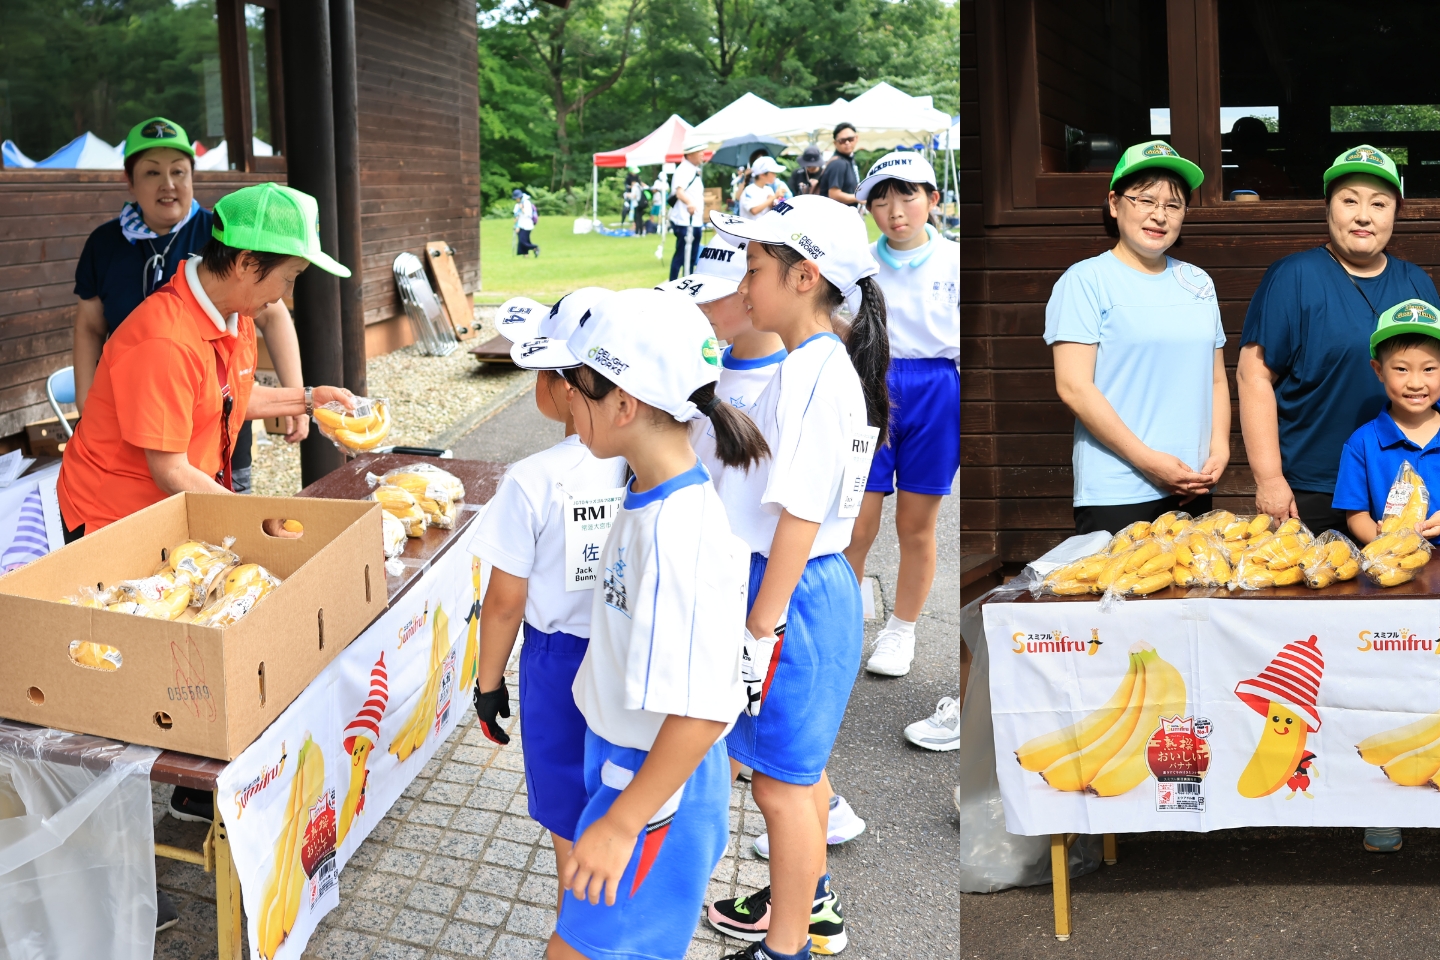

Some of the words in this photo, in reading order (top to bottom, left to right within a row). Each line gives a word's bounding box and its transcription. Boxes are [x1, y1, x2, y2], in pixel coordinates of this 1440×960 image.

[798, 241, 819, 260] WORKS
[594, 356, 622, 376] WORKS
[851, 439, 869, 454] RM
[573, 505, 605, 522] RM
[575, 566, 593, 575] Jack
[575, 574, 597, 582] Bunny
[1012, 631, 1086, 654] Sumifru
[1357, 630, 1433, 652] Sumifru
[1166, 724, 1189, 732] Sumifru
[1158, 751, 1202, 762] おいしい
[1169, 761, 1193, 770] バナナ
[235, 764, 279, 820] Sumifru
[307, 827, 335, 858] おいしい
